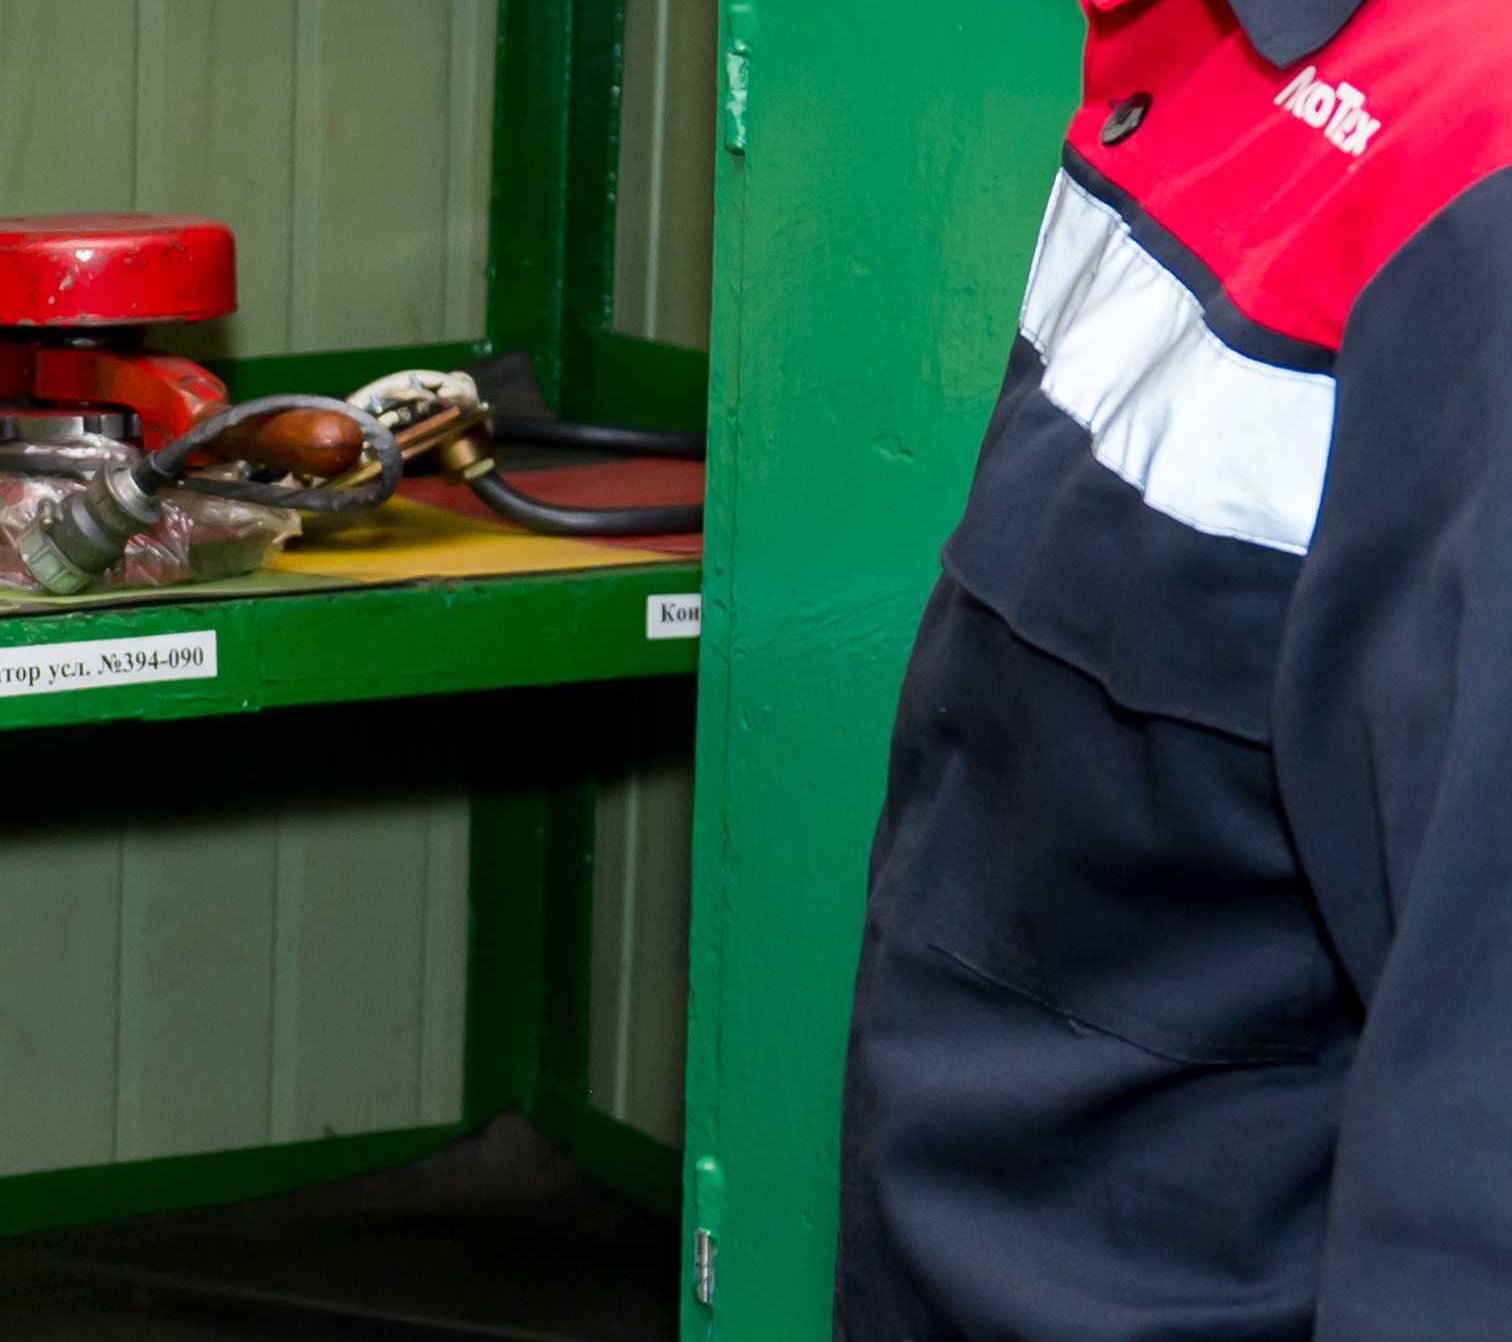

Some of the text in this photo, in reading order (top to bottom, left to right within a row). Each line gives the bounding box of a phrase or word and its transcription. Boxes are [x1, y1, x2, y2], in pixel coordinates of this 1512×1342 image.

[661, 602, 700, 623] Кон
[48, 658, 91, 685] усл.
[98, 646, 205, 675] №394-090
